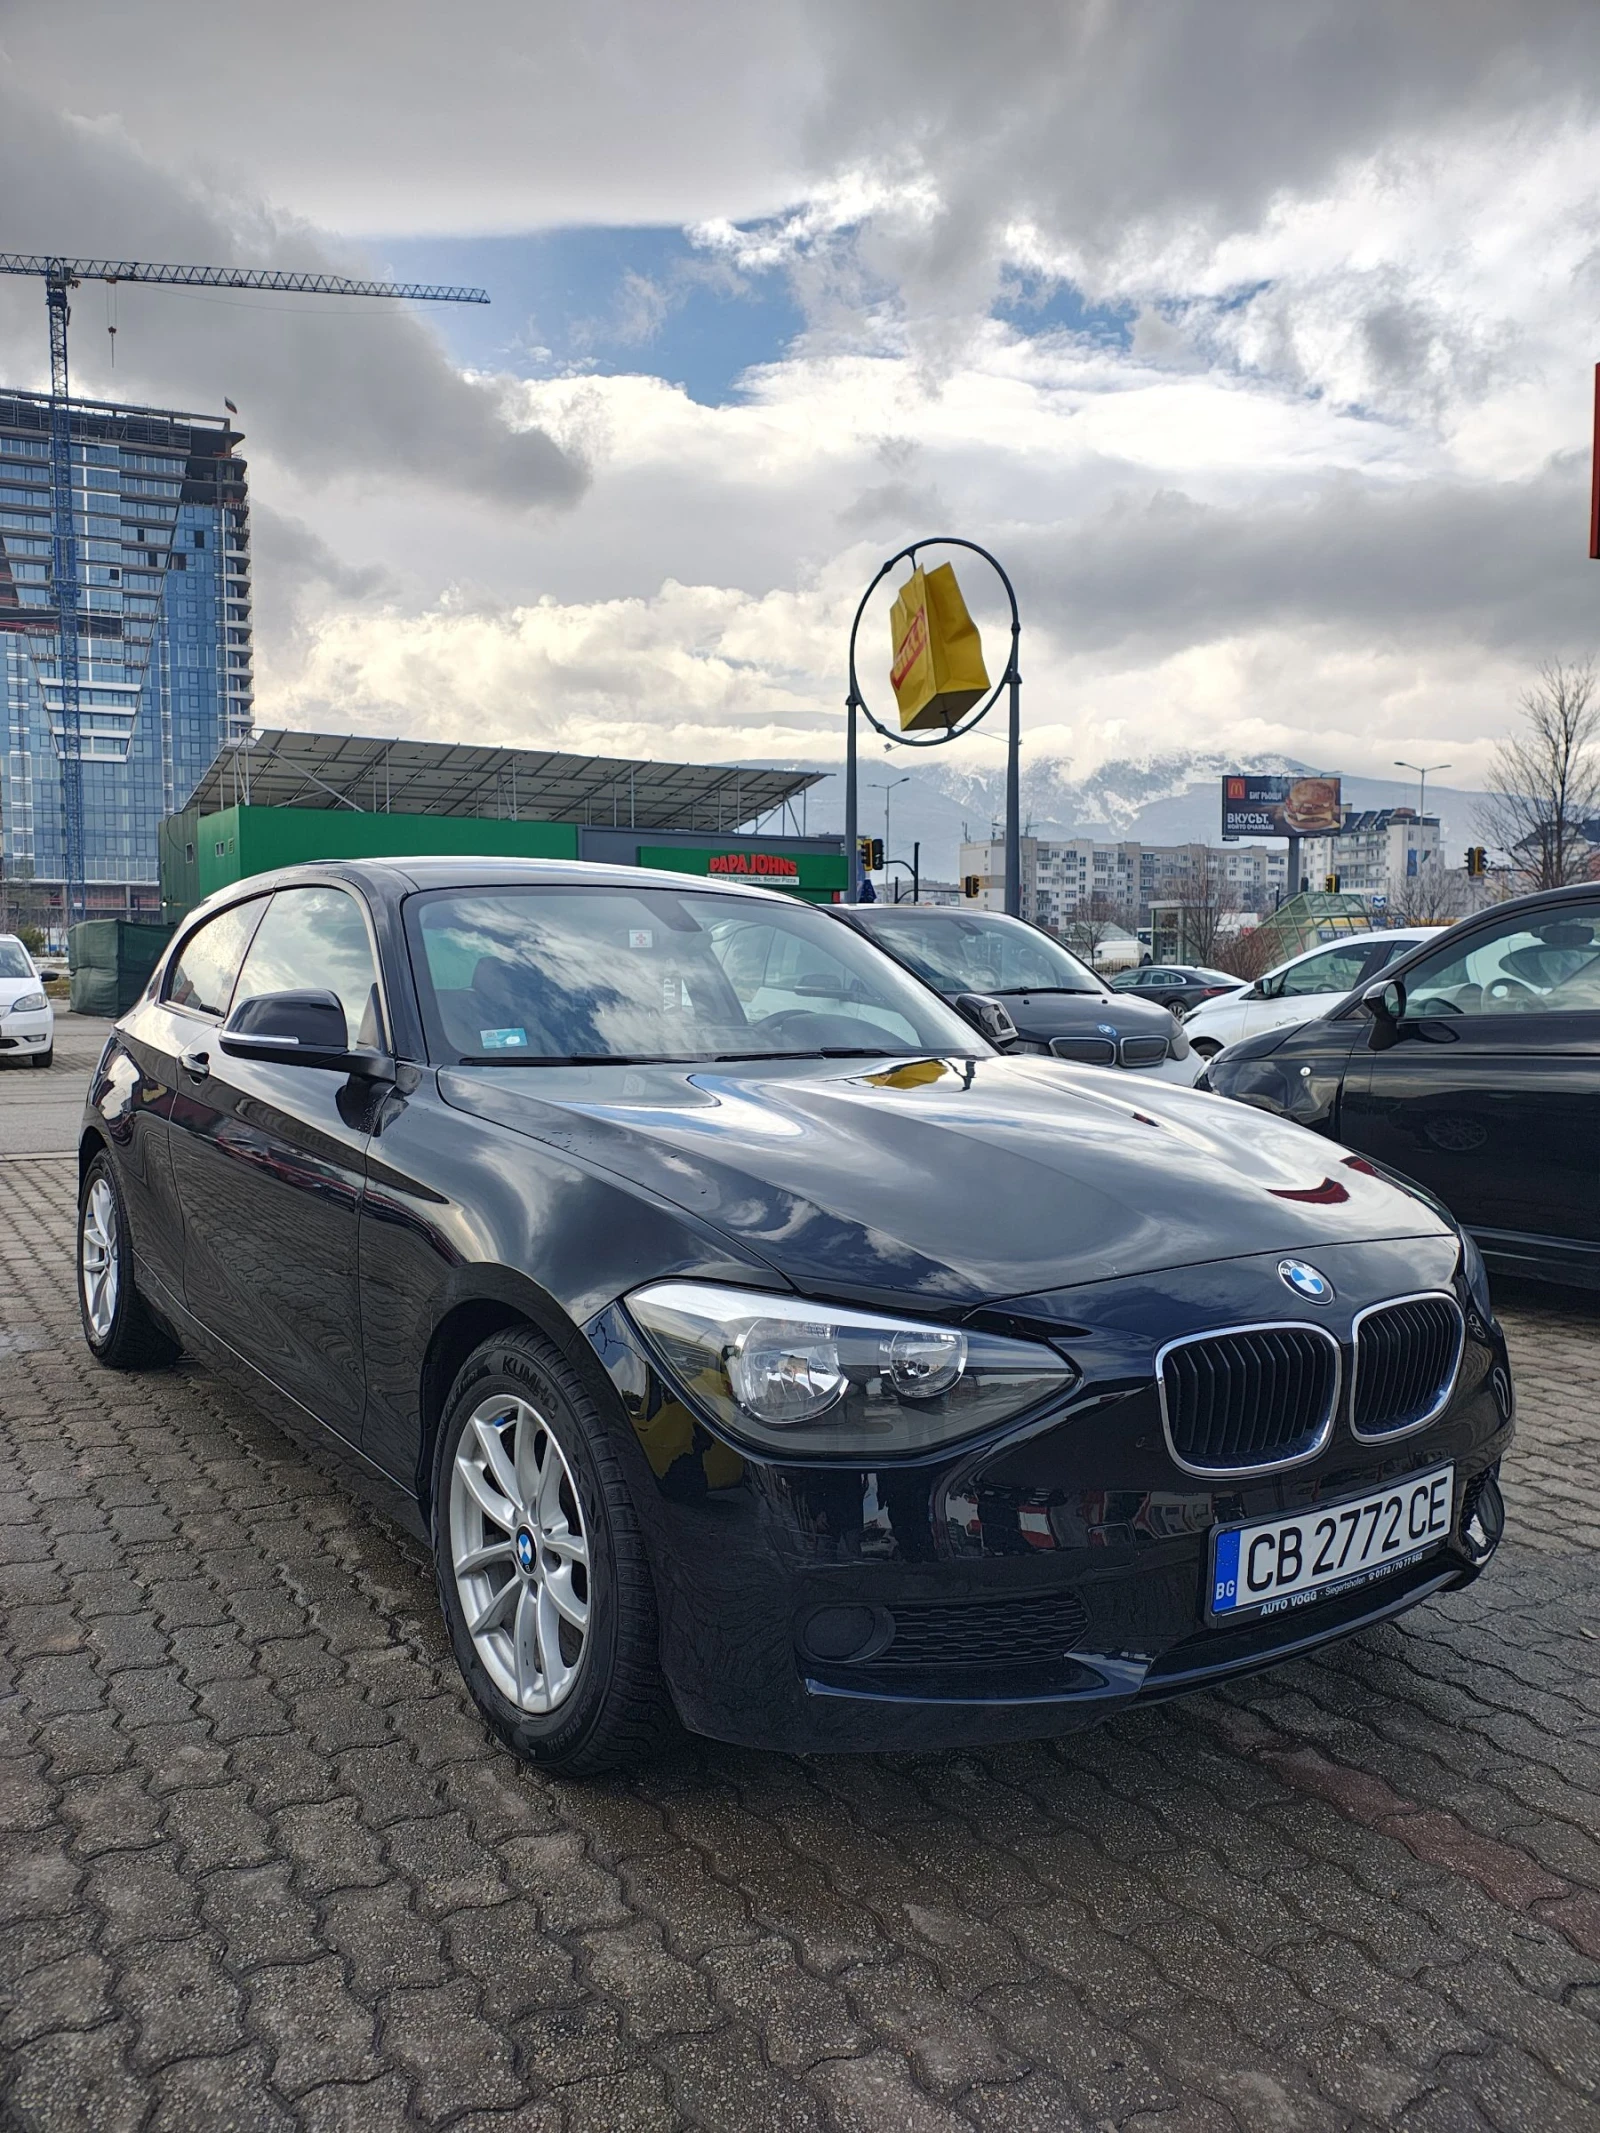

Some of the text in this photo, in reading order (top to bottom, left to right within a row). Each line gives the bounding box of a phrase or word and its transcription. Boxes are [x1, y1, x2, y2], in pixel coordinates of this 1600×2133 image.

[1249, 791, 1260, 800] БИГ
[709, 854, 797, 875] PAPA JOHNS
[663, 978, 676, 1011] VIP
[1247, 1476, 1448, 1592] CB 2772 CE
[1215, 1580, 1235, 1600] BG
[1260, 1599, 1288, 1616] AUTO
[1290, 1591, 1317, 1607] VOGG
